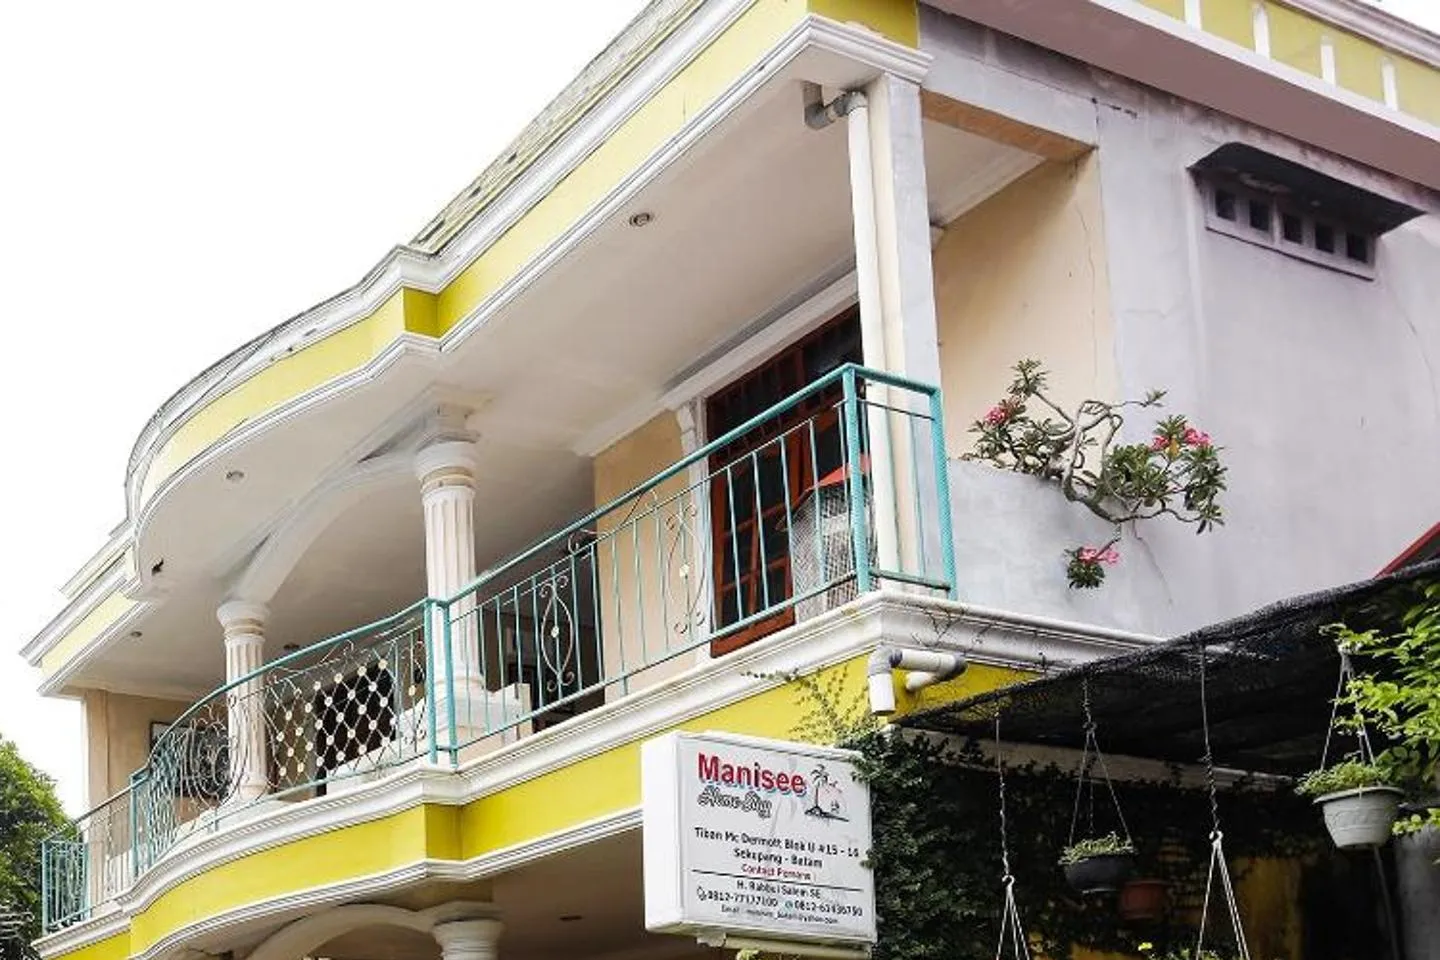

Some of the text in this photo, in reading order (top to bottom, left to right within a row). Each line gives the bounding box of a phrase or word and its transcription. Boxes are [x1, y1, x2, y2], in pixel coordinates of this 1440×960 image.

[698, 753, 807, 795] Manisee
[785, 838, 805, 851] Blok
[790, 854, 823, 868] Batam
